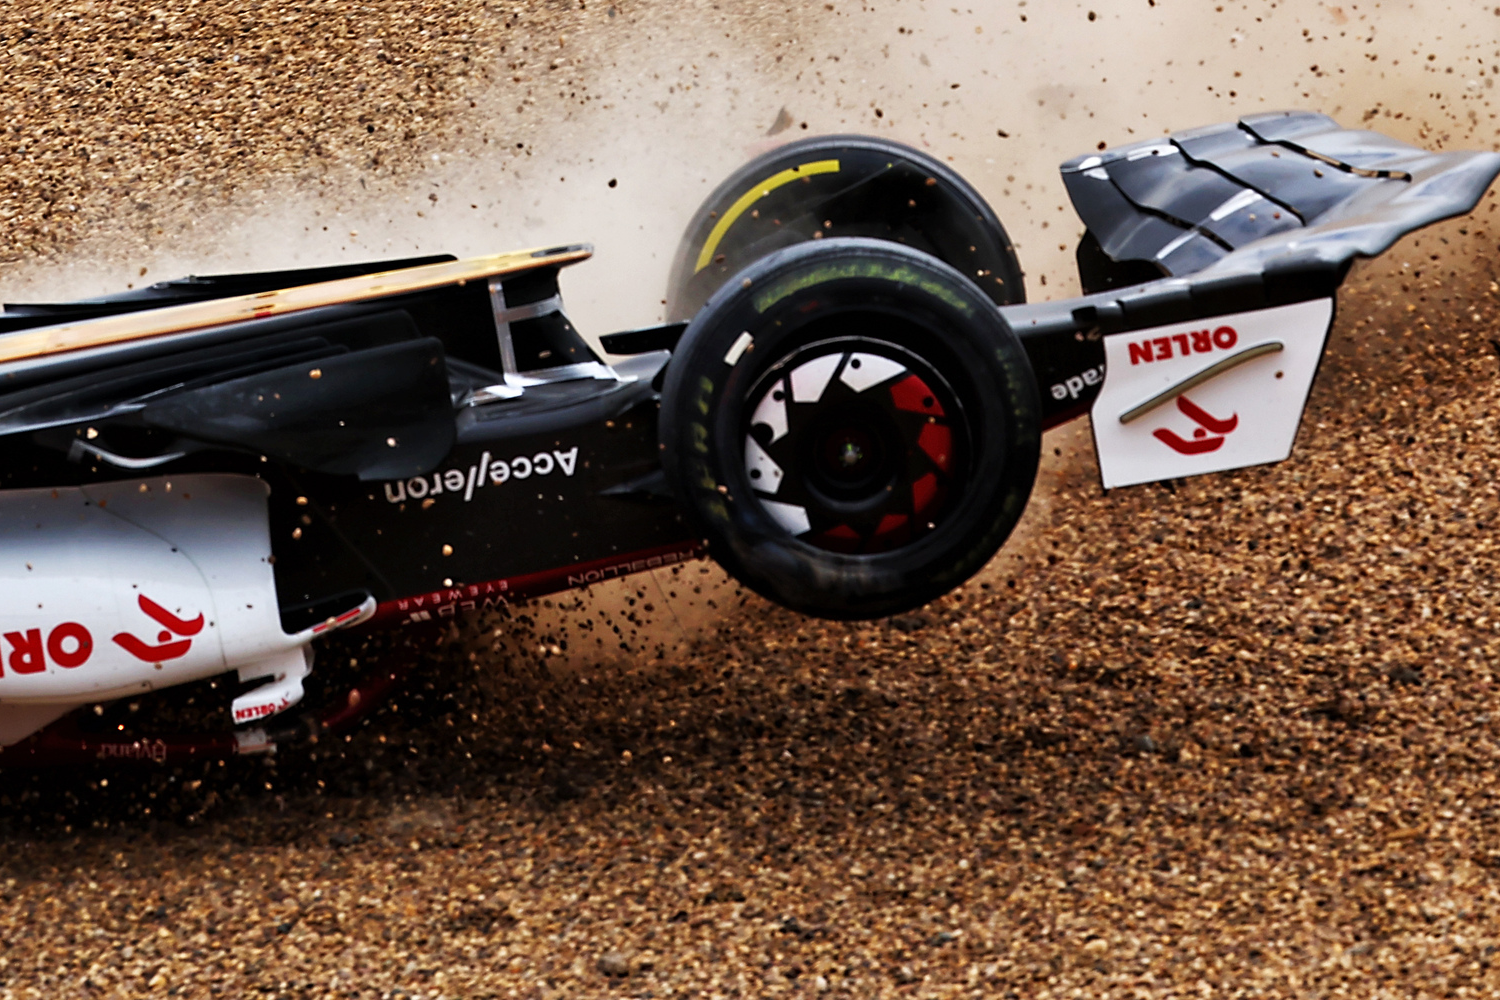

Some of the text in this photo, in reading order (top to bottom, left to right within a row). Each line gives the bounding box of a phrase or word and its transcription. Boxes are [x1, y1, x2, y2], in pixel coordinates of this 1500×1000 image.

[1128, 325, 1238, 366] ORLEN
[383, 445, 580, 504] Accelleron
[397, 579, 509, 611] EYEWEAR
[235, 701, 276, 720] ORLEN
[100, 738, 167, 763] Hyland
